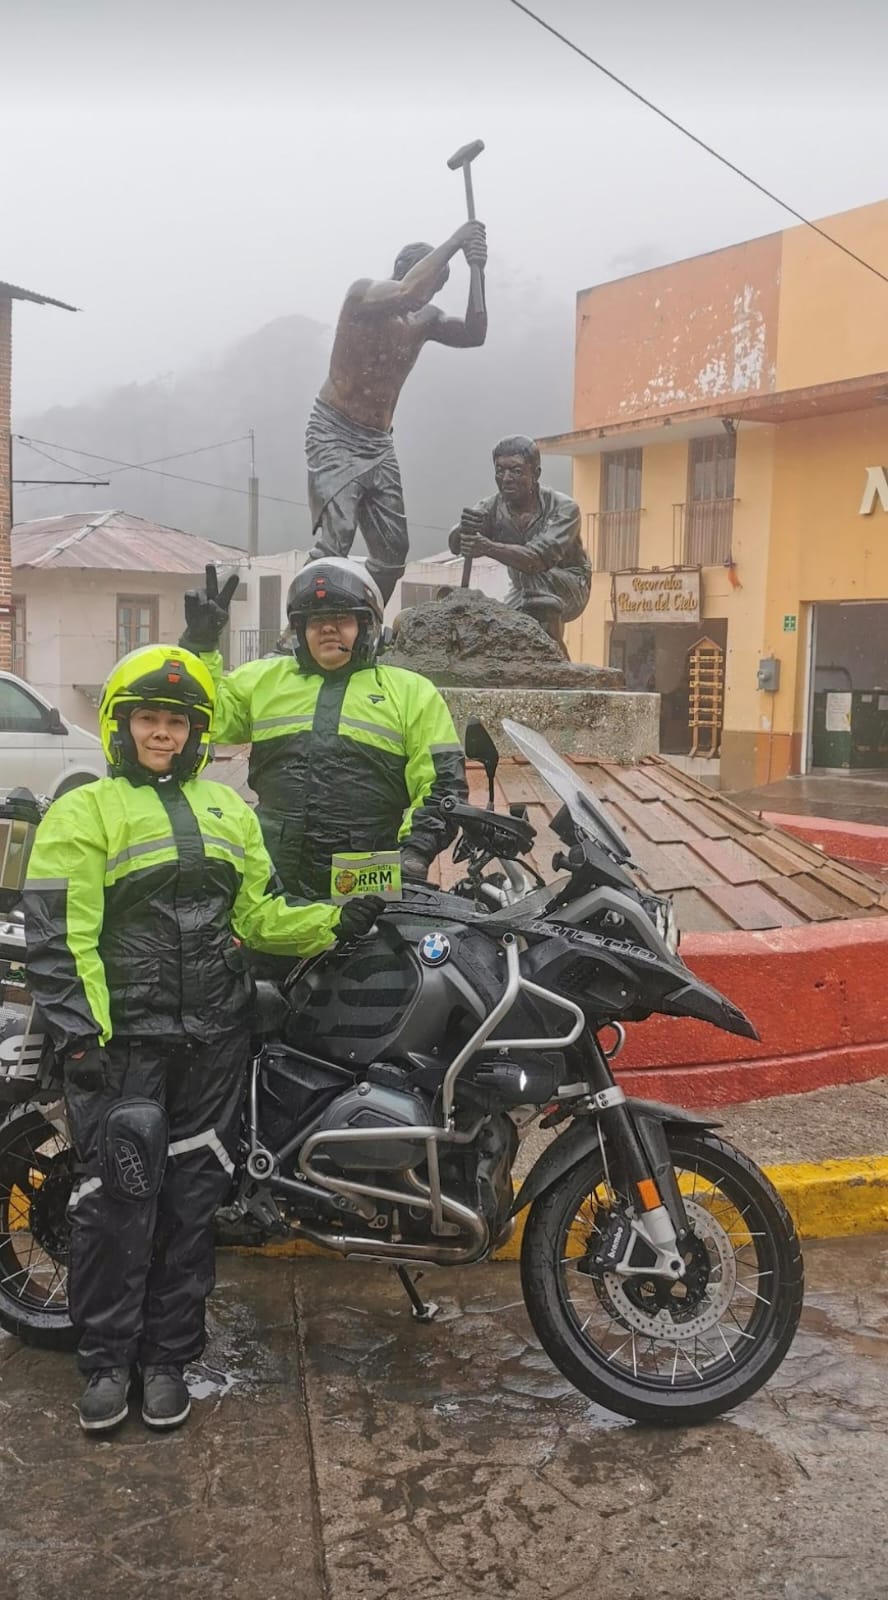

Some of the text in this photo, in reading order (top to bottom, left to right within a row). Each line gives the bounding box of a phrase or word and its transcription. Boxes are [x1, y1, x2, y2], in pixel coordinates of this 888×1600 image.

[617, 591, 698, 612] Puerta del Cielo
[358, 871, 392, 886] RRM
[607, 1226, 624, 1259] brembo
